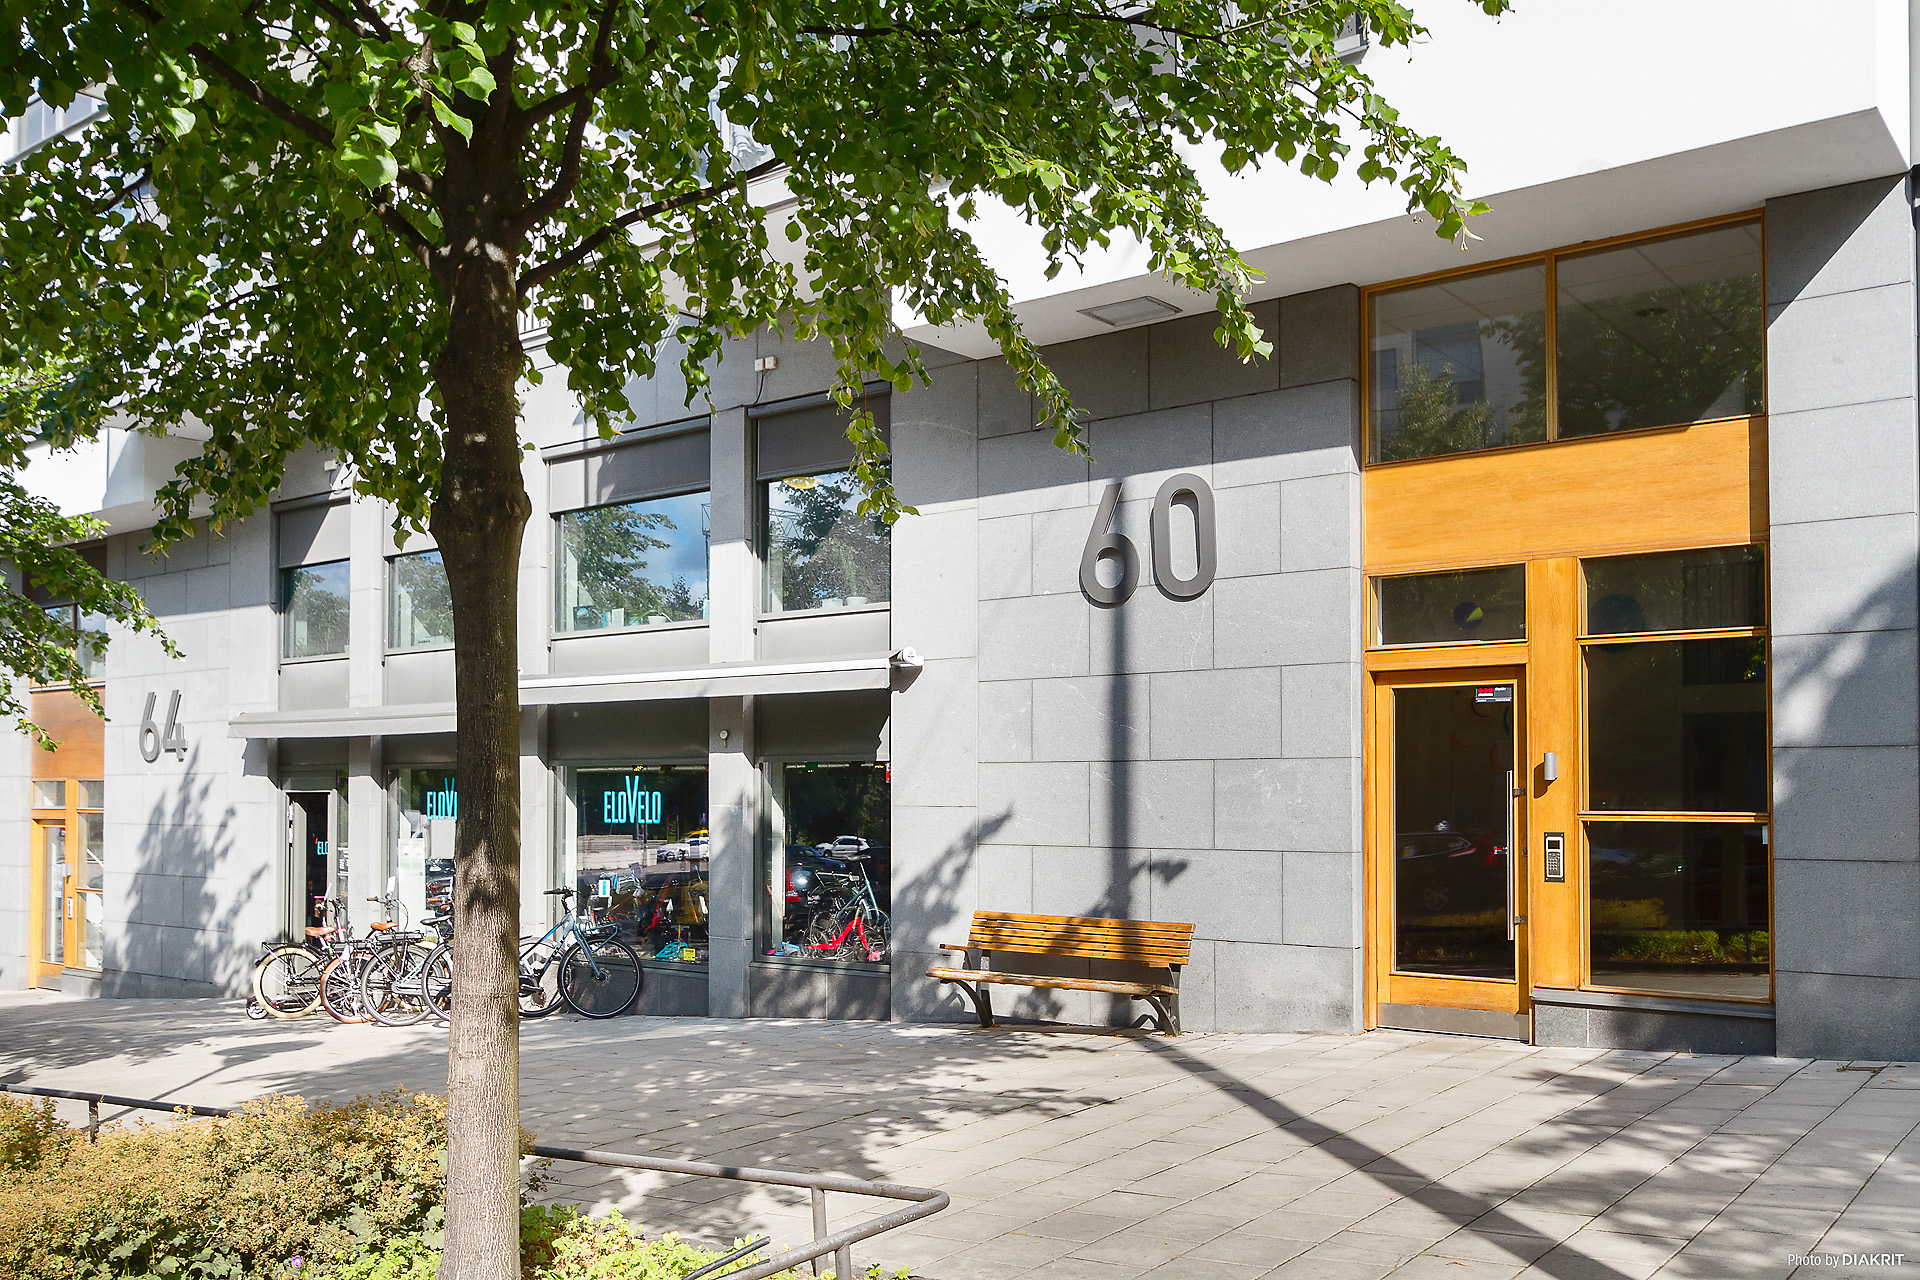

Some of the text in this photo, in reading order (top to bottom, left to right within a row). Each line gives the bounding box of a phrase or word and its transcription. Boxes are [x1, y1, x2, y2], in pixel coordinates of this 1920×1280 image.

[1080, 472, 1217, 605] 60
[139, 689, 188, 763] 64
[603, 775, 662, 825] ELOVELO
